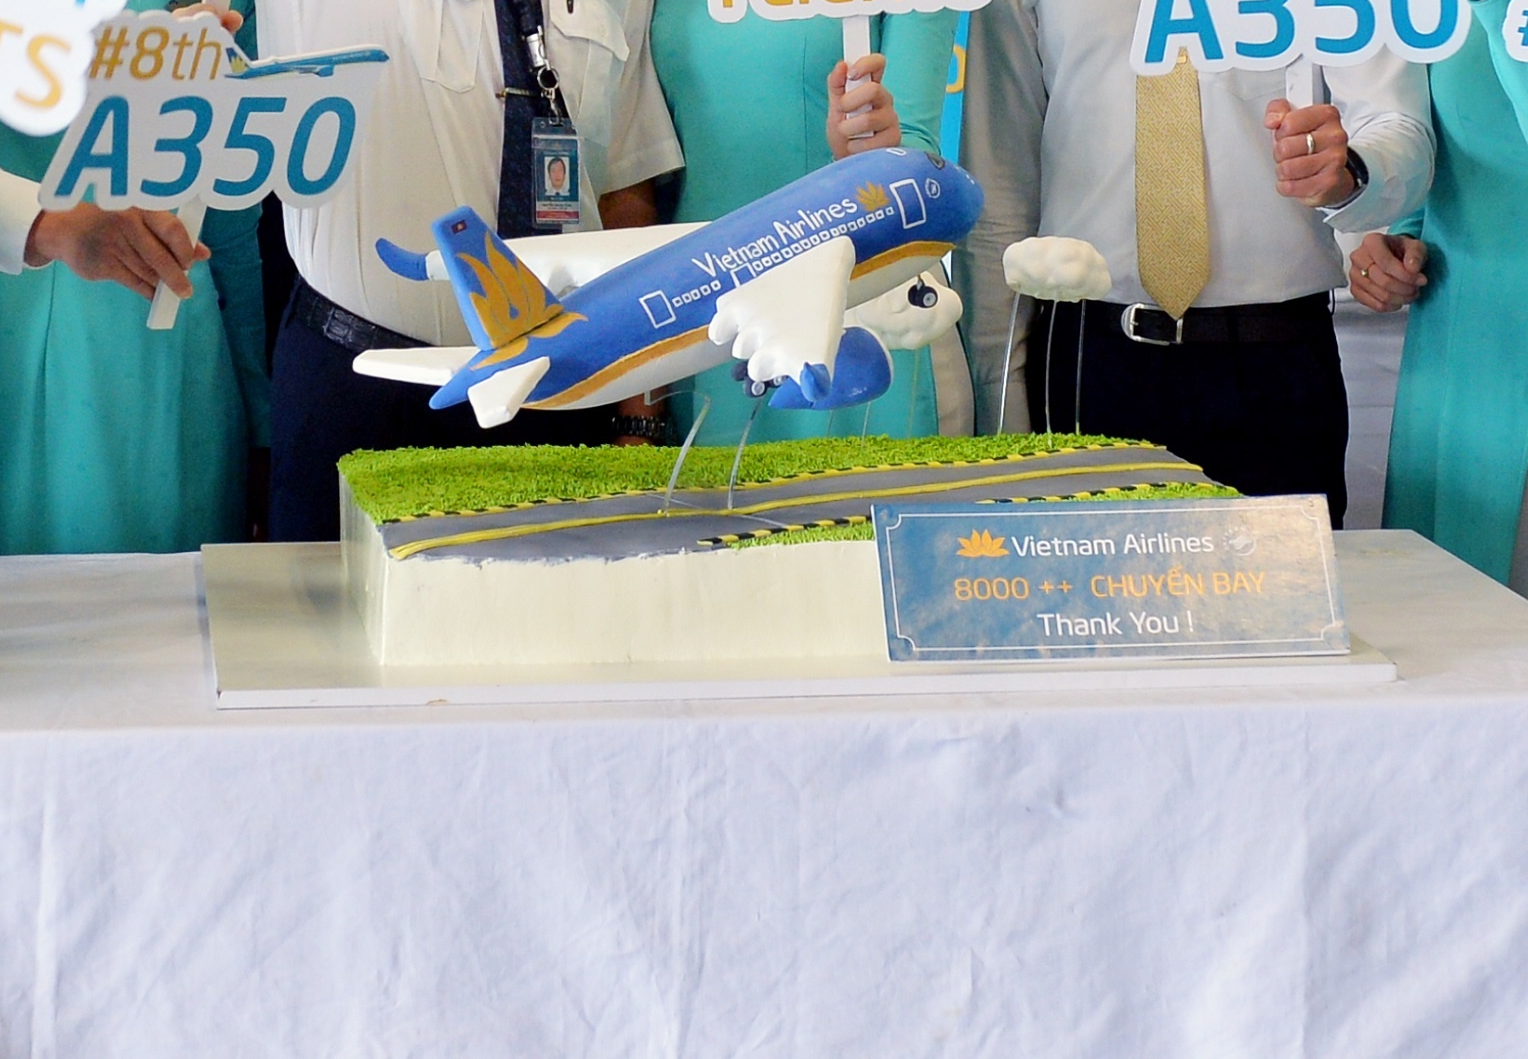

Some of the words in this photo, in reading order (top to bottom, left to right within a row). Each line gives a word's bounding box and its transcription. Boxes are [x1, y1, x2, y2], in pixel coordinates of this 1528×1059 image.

[88, 26, 223, 82] #8th
[54, 95, 357, 198] A350
[691, 234, 784, 278] Vietnam
[773, 198, 859, 245] Airlines
[1011, 536, 1116, 557] Vietnam
[1123, 532, 1215, 555] Airlines
[954, 577, 1030, 601] 8000
[1091, 565, 1205, 599] CHUYẾN
[1213, 570, 1266, 596] BAY
[1037, 612, 1122, 637] Thank
[1132, 611, 1180, 635] You
